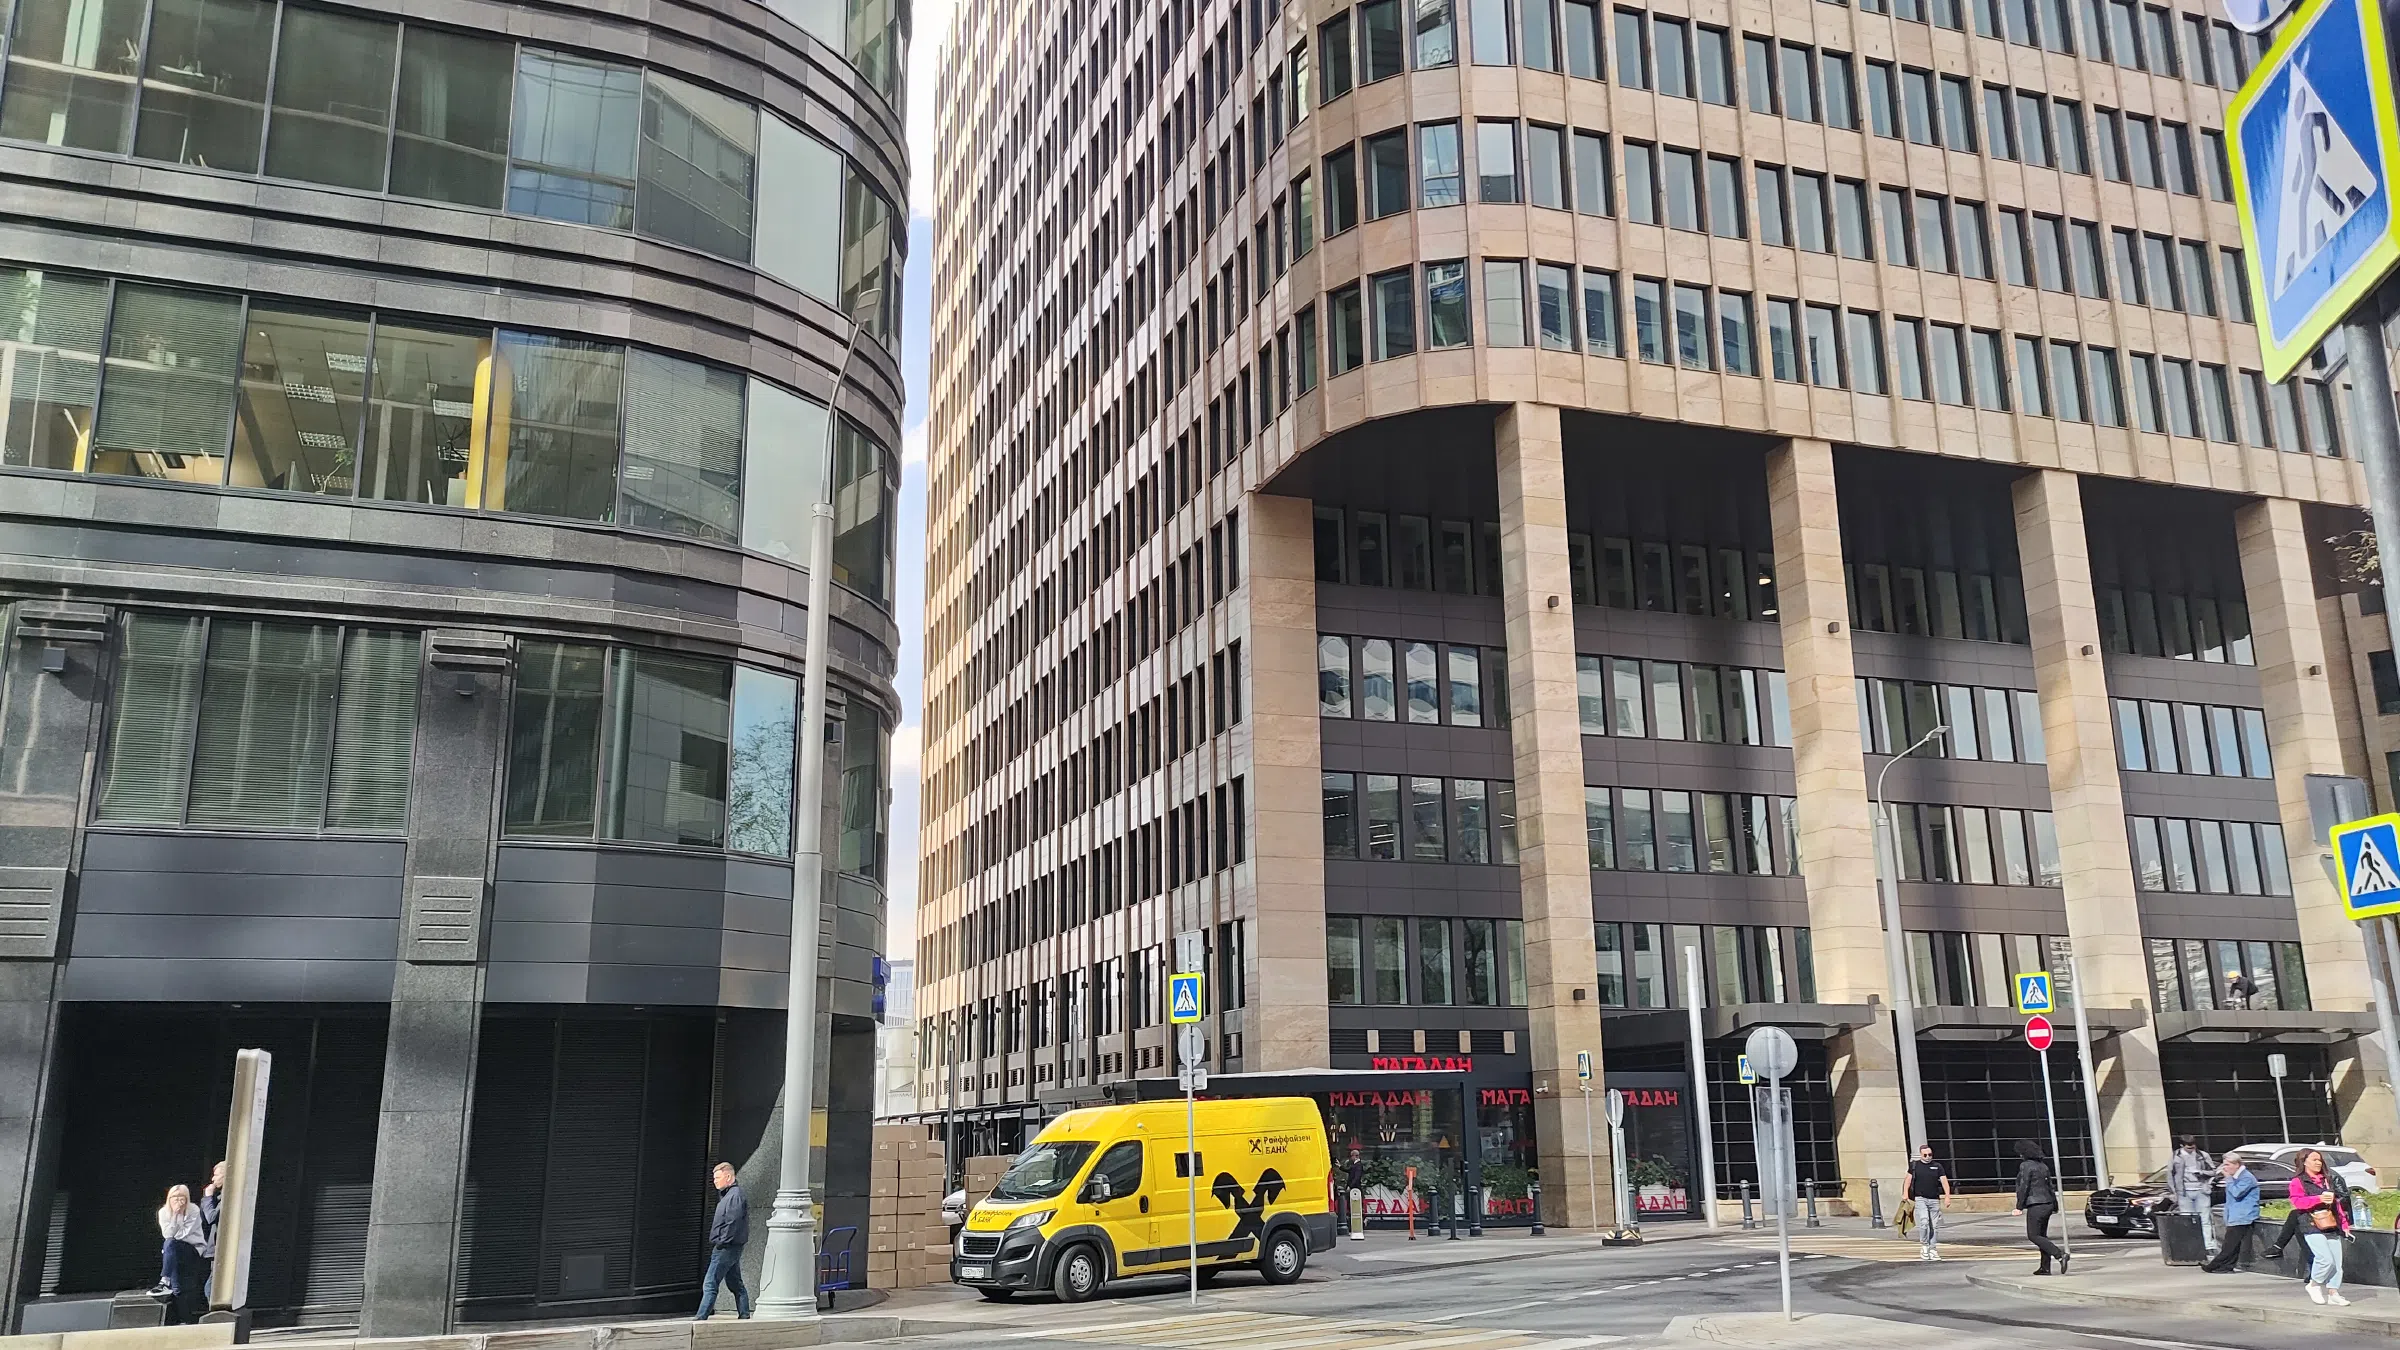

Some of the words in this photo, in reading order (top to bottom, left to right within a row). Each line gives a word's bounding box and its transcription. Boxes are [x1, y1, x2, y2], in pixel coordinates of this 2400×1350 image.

[1372, 1056, 1473, 1072] МАГАДАН
[1329, 1090, 1430, 1106] МАГАДАН
[1263, 1134, 1311, 1145] Райффайзен
[1265, 1145, 1288, 1154] БАНК
